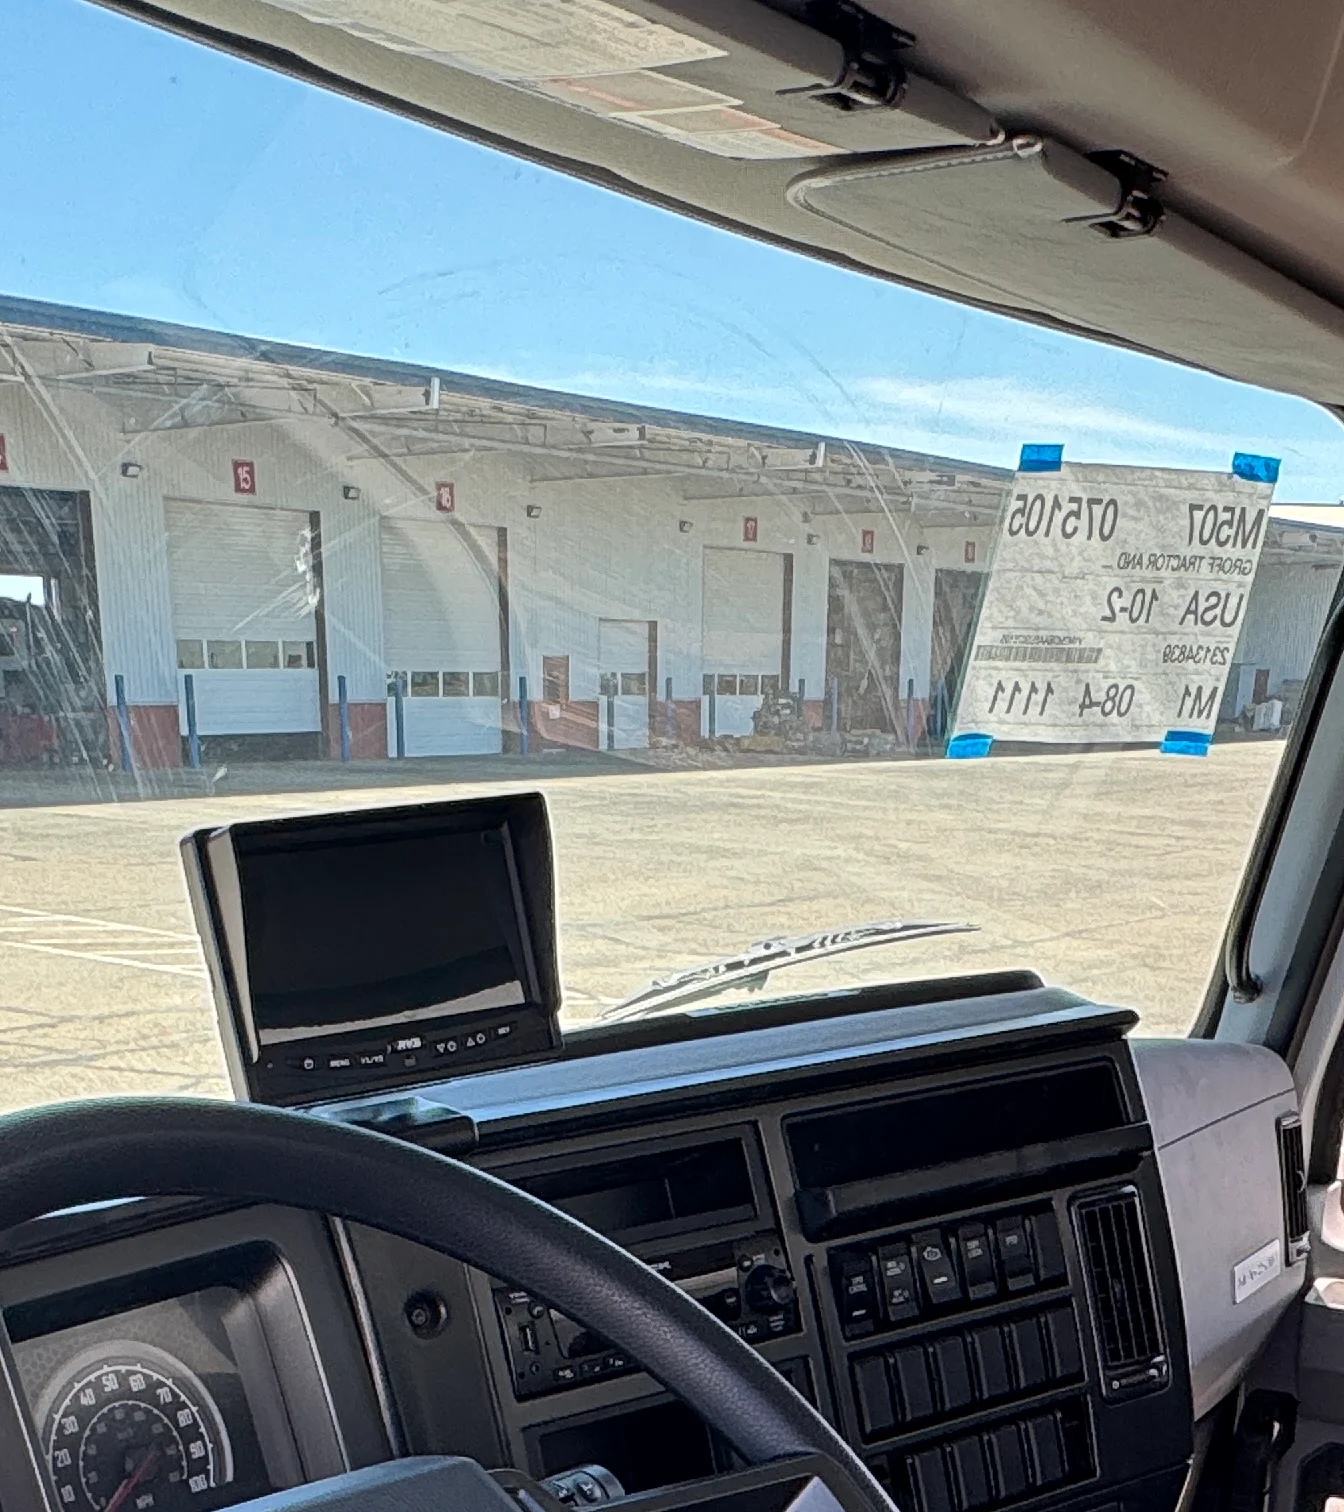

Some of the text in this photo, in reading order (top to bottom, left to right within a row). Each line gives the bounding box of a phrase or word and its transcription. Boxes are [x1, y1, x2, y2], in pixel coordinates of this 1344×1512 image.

[237, 466, 252, 489] 15
[102, 1373, 119, 1392] 50
[129, 1374, 146, 1392] 60
[80, 1388, 97, 1406] 40
[156, 1386, 173, 1404] 70
[60, 1415, 80, 1436] 30
[54, 1449, 72, 1468] 20
